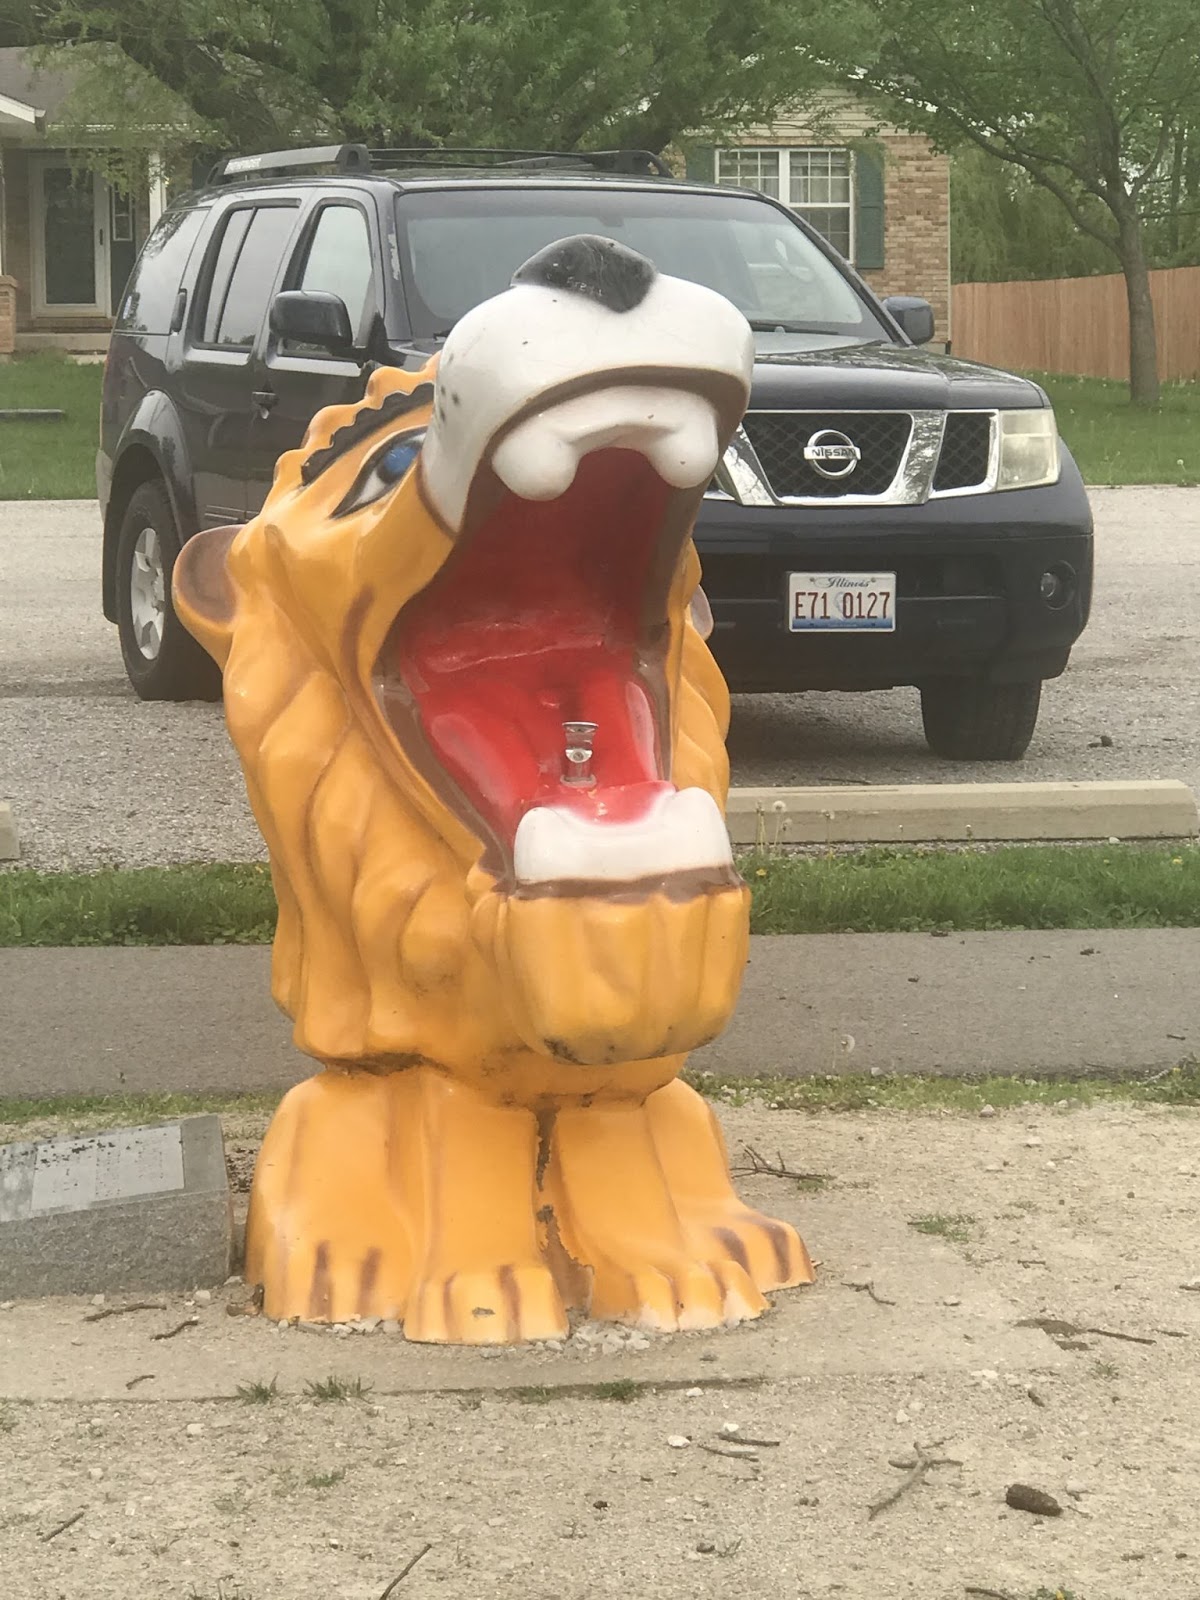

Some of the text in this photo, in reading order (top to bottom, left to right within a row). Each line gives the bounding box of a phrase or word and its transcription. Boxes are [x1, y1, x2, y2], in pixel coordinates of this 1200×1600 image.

[811, 447, 856, 457] NISSAN
[815, 577, 870, 589] Illinois
[795, 591, 891, 619] E71 0127
